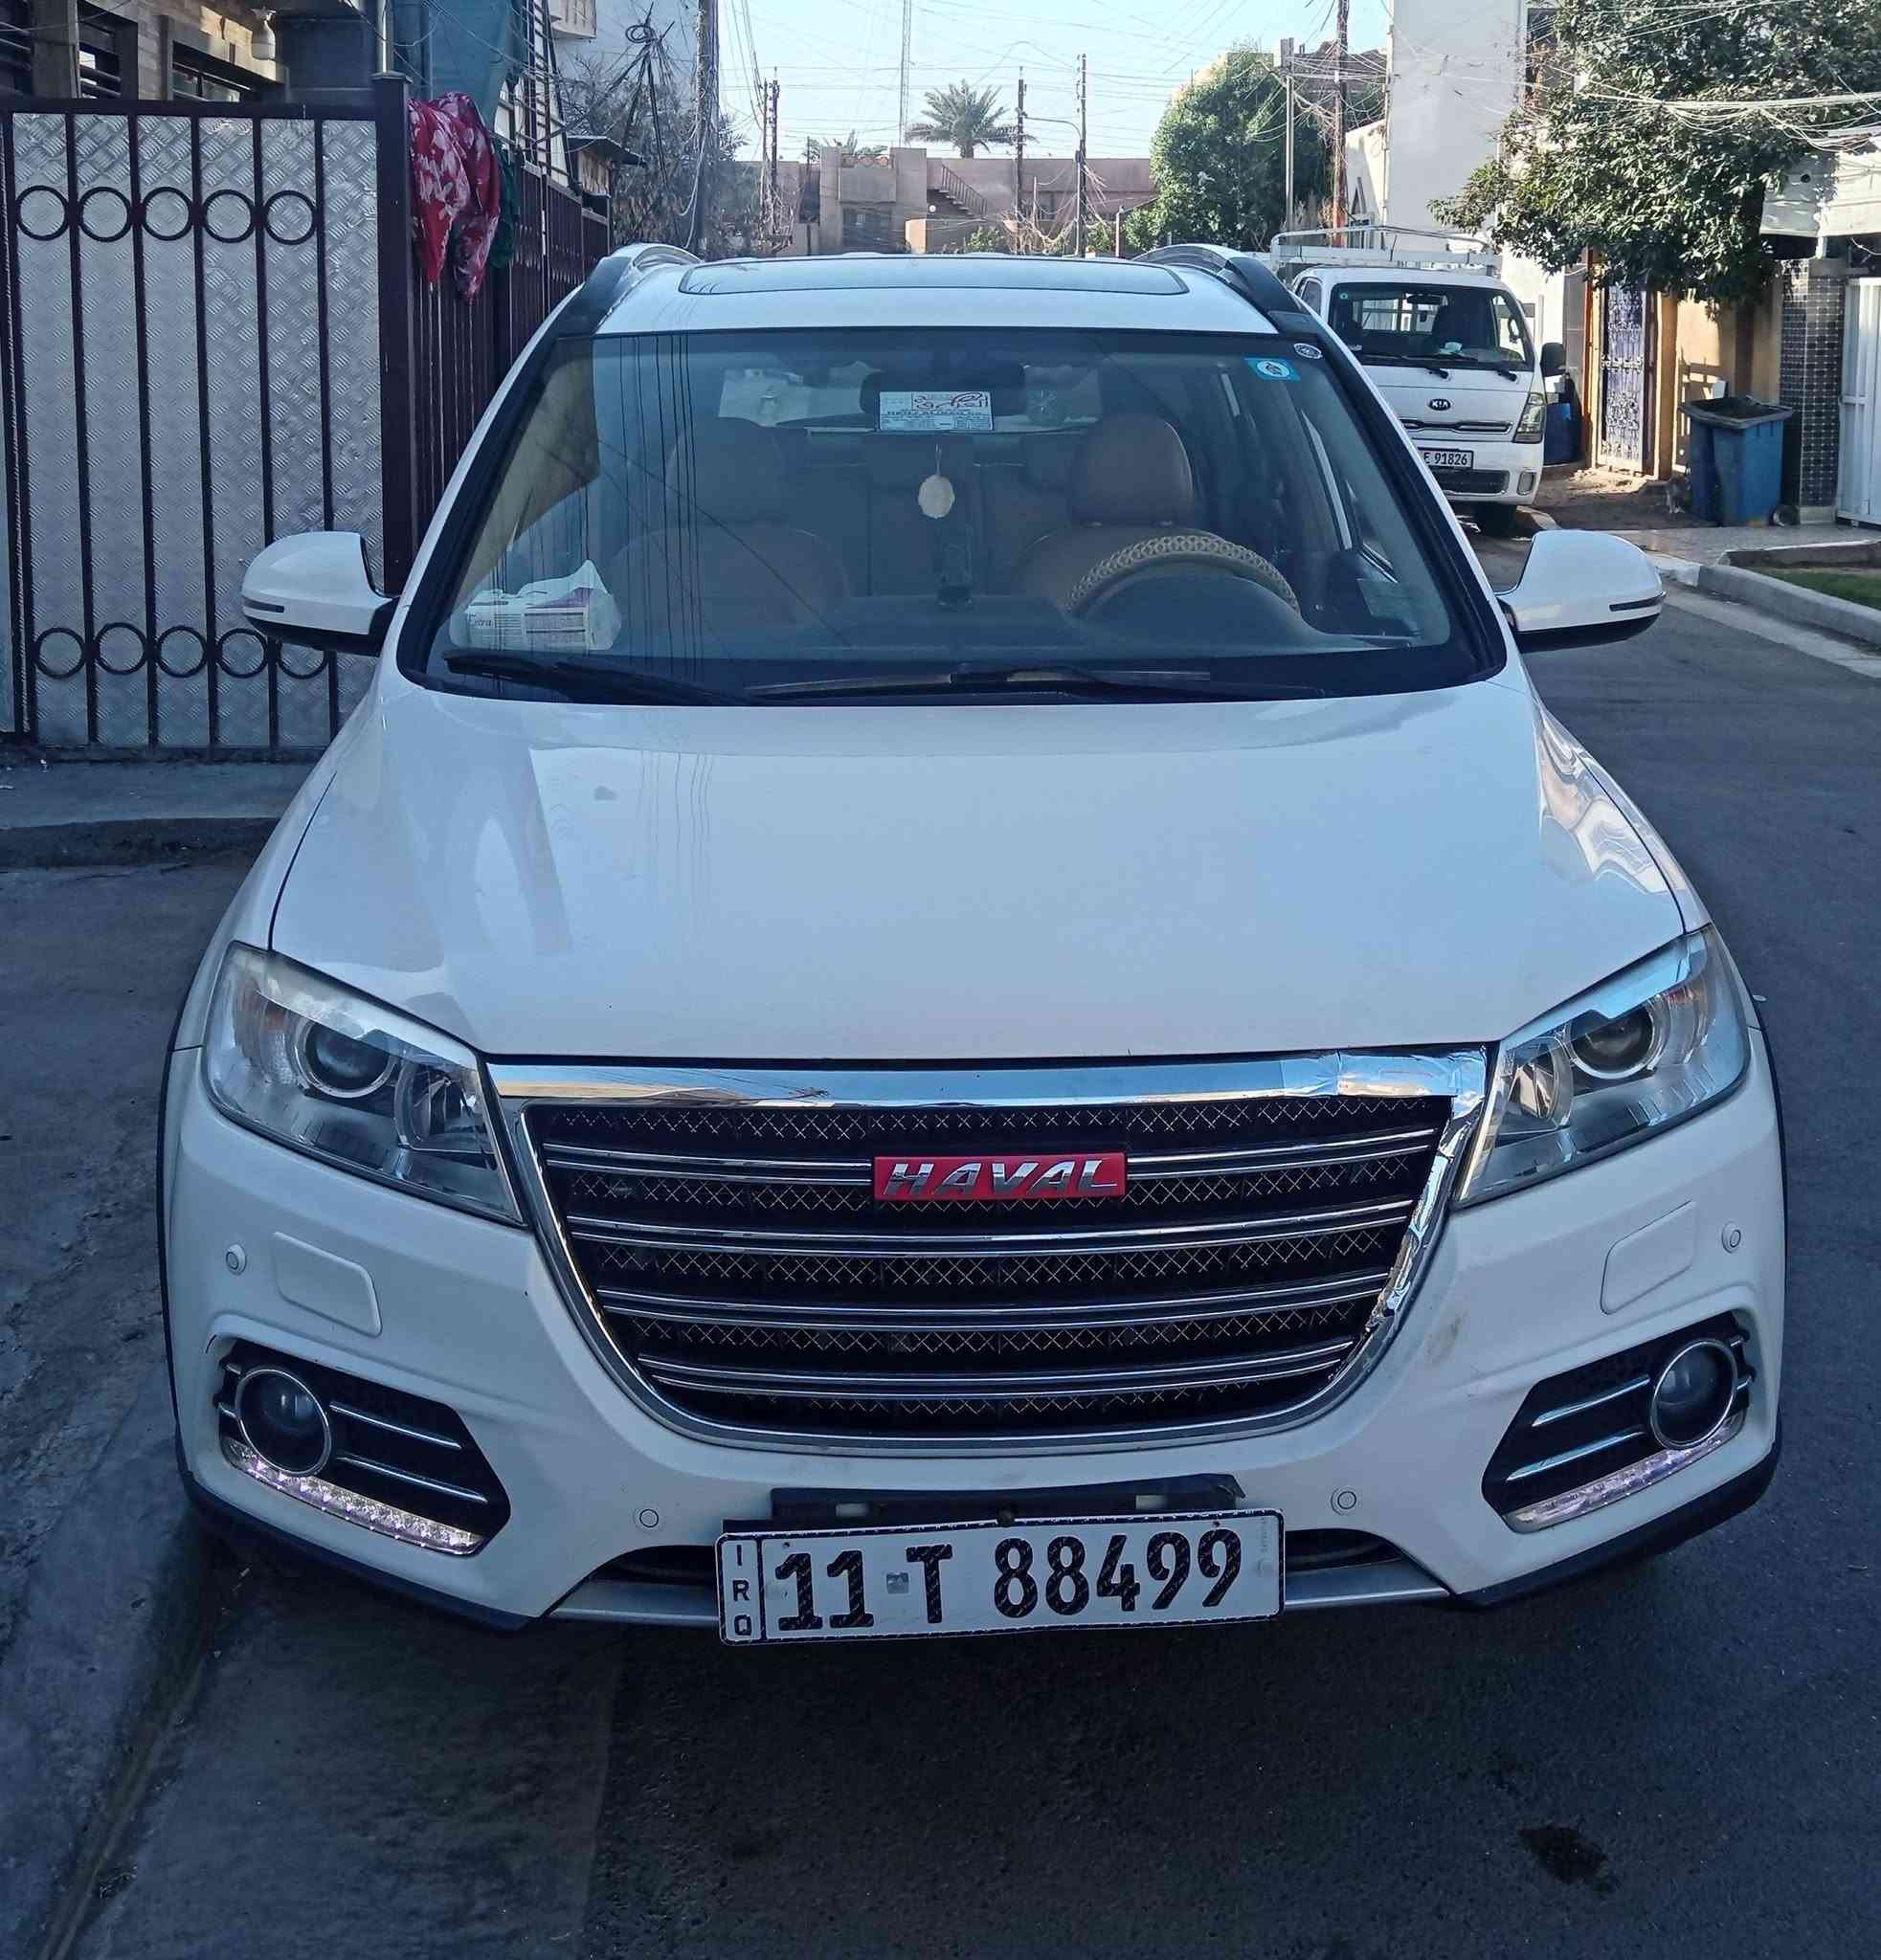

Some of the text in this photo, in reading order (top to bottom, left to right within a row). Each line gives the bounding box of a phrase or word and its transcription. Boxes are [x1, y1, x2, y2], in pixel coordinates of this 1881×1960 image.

[1431, 400, 1449, 409] KIA
[1434, 453, 1468, 466] 91826
[883, 1159, 1118, 1196] HAVAL
[773, 1548, 875, 1631] 11
[906, 1543, 953, 1624] T
[993, 1528, 1243, 1619] 88499
